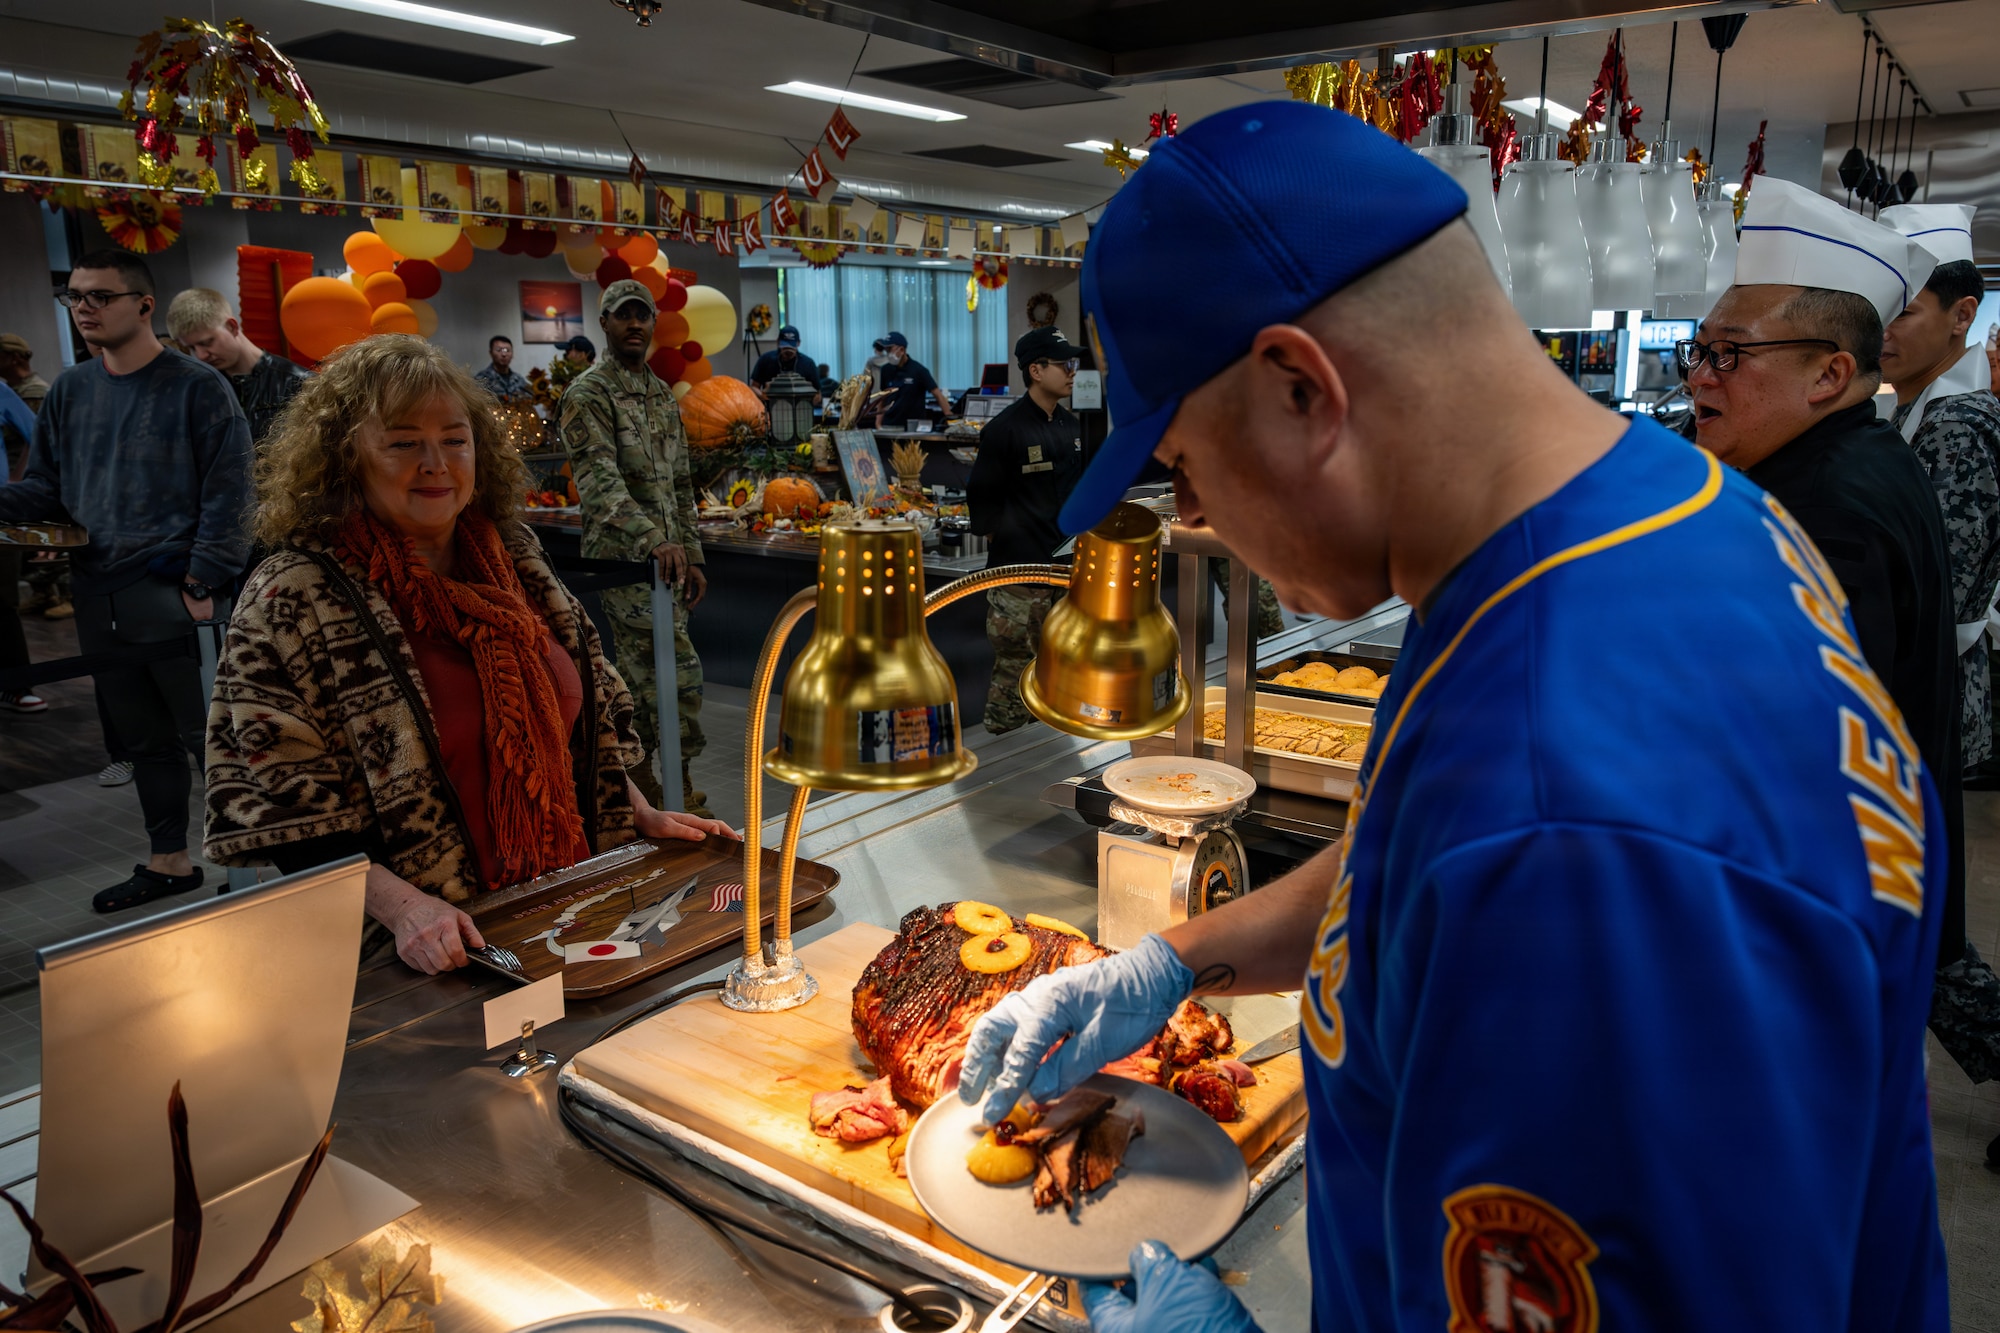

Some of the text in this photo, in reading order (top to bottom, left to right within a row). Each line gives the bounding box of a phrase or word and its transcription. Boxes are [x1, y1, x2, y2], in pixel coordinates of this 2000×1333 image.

[630, 124, 851, 255] THANKFUL
[1651, 326, 1677, 343] ICE
[511, 873, 633, 920] Misawa Air Base
